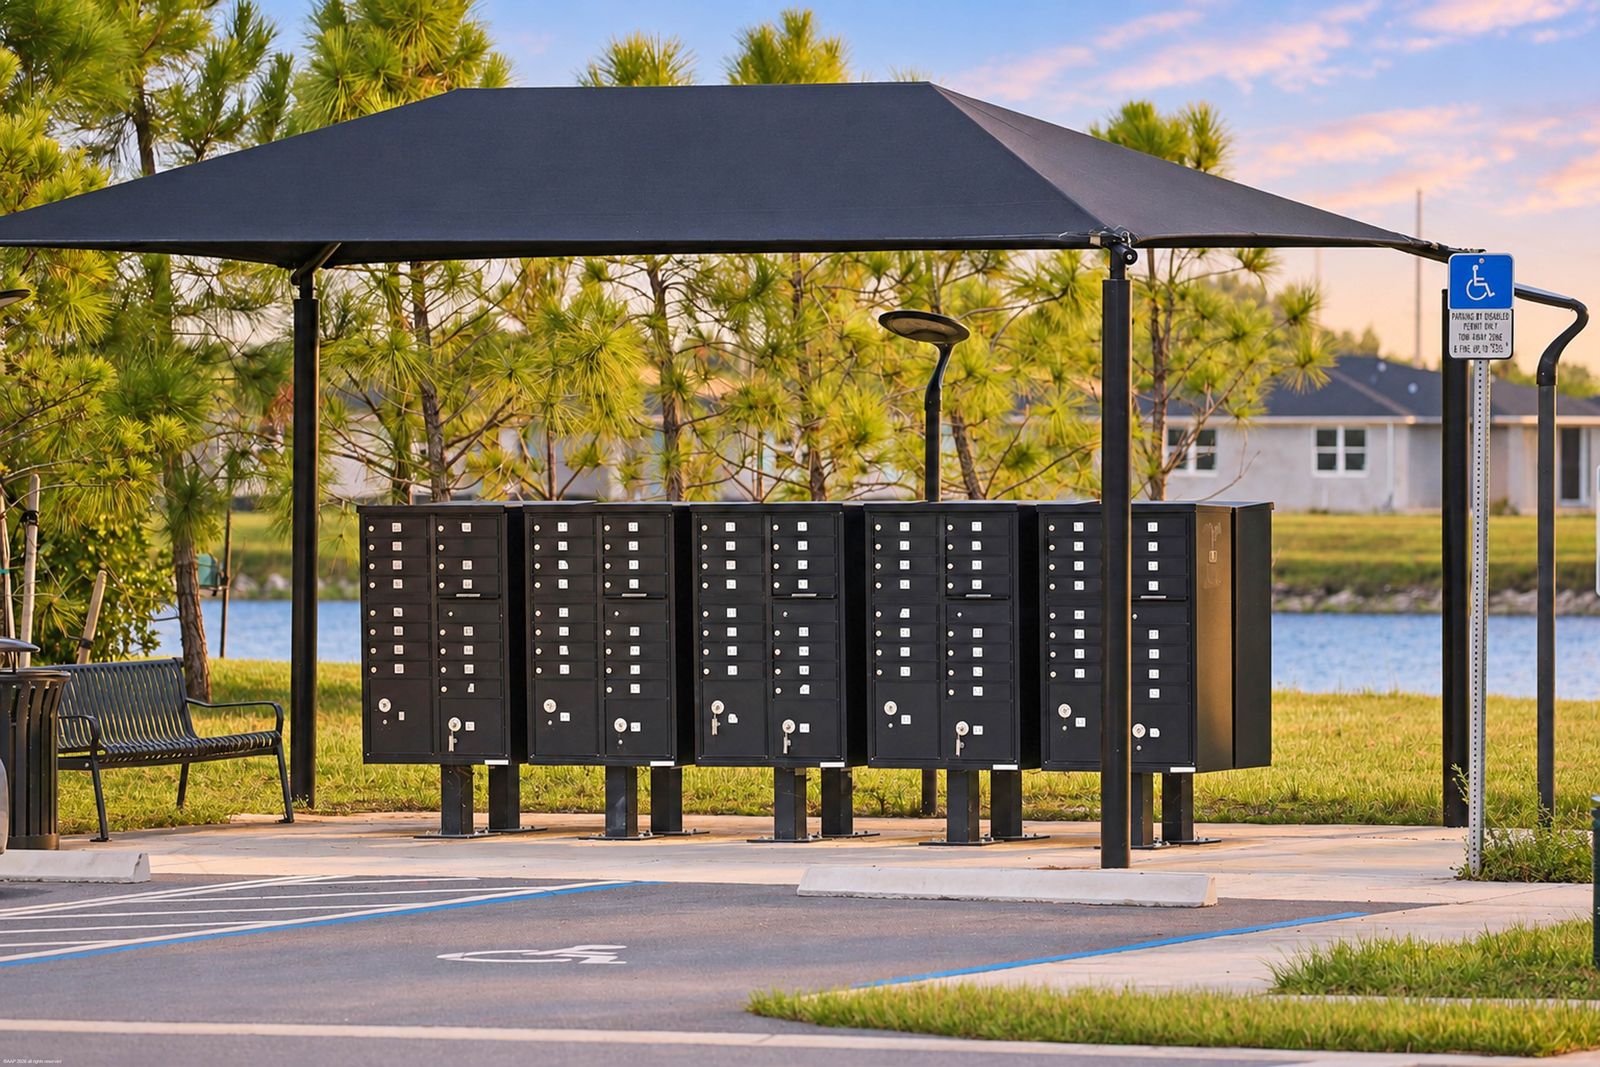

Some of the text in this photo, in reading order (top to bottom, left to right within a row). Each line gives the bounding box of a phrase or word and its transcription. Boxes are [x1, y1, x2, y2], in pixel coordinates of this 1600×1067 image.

[1452, 312, 1474, 320] PARKING
[1485, 312, 1509, 320] DISABLED
[1463, 322, 1482, 330] PERMIT
[1489, 333, 1503, 341] ZONE
